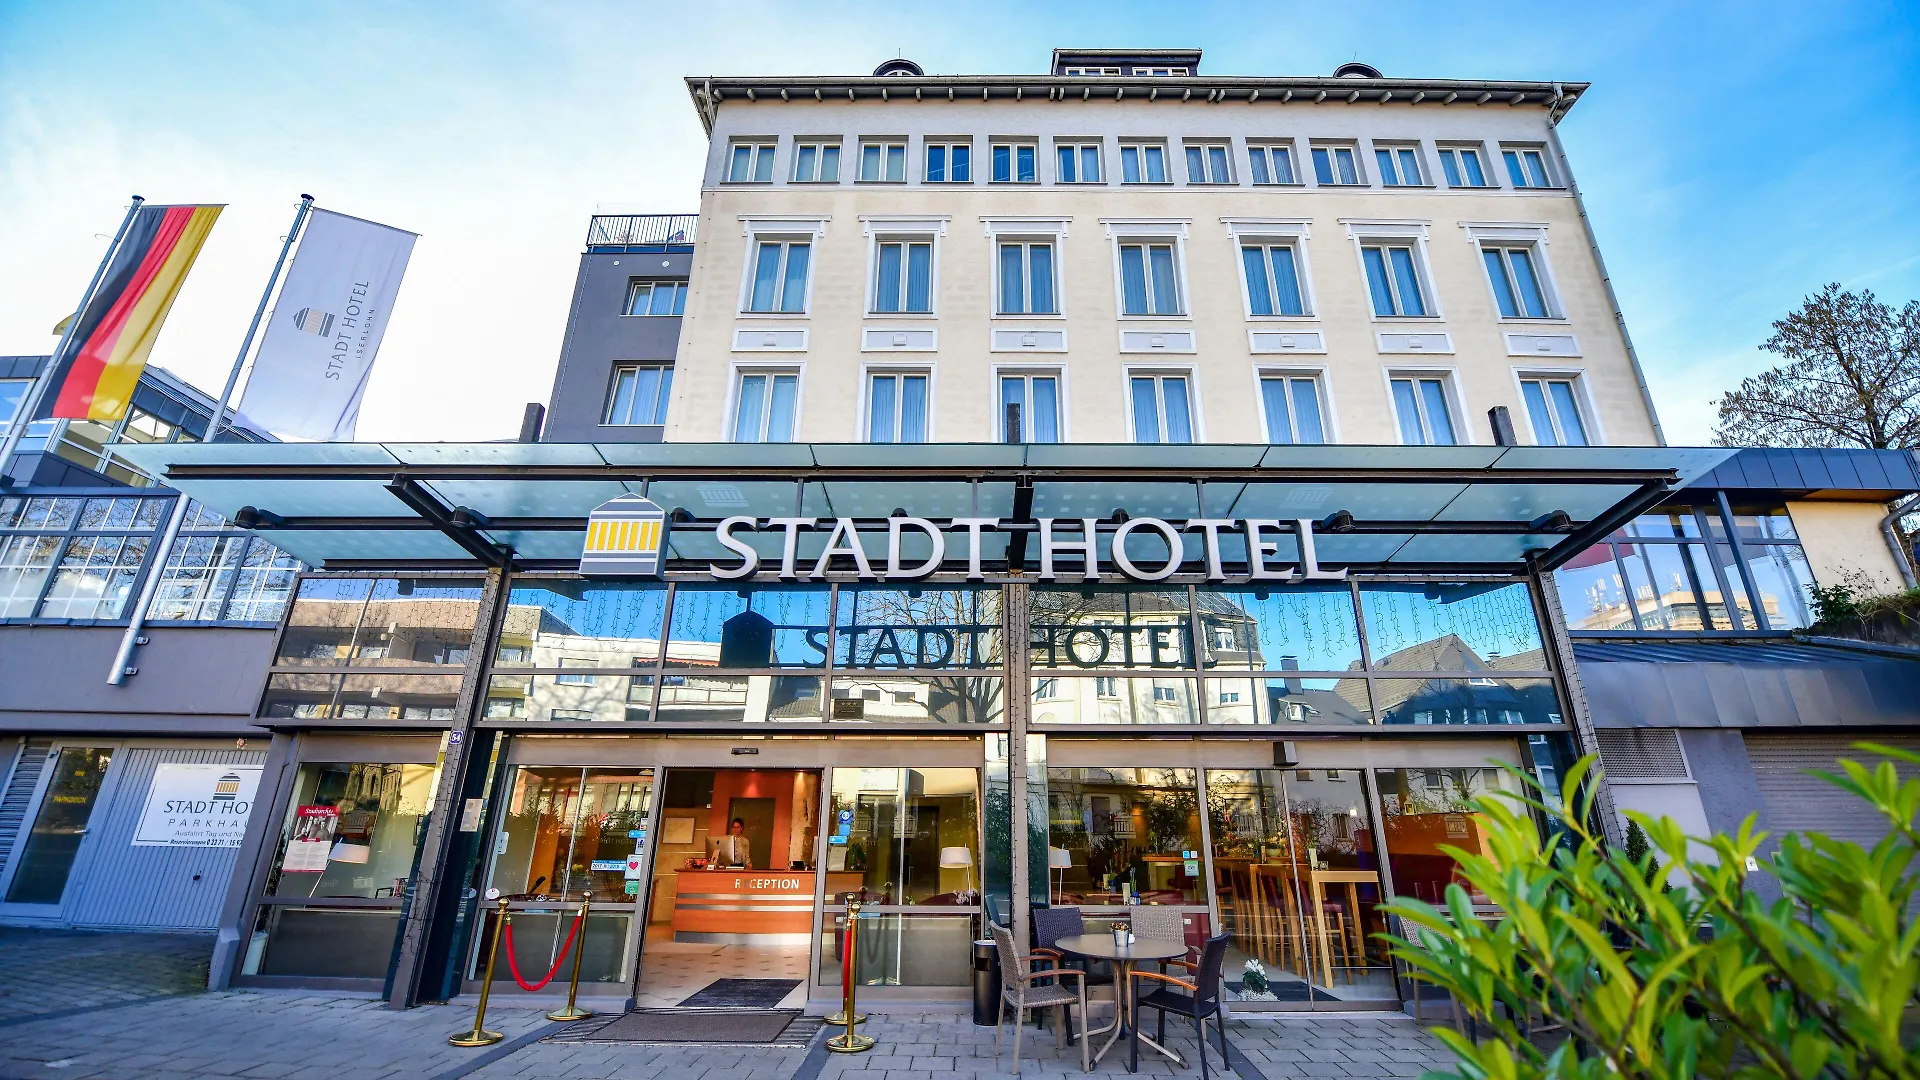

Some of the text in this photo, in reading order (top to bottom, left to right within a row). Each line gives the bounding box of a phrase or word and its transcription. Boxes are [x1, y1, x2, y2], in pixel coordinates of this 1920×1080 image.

[325, 281, 369, 380] STADT HOTEL
[355, 309, 375, 359] ISERLOHN
[709, 516, 1348, 583] STADT HOTEL
[451, 733, 461, 742] 54
[163, 800, 254, 814] STADT HO
[734, 878, 800, 890] RCEPTION
